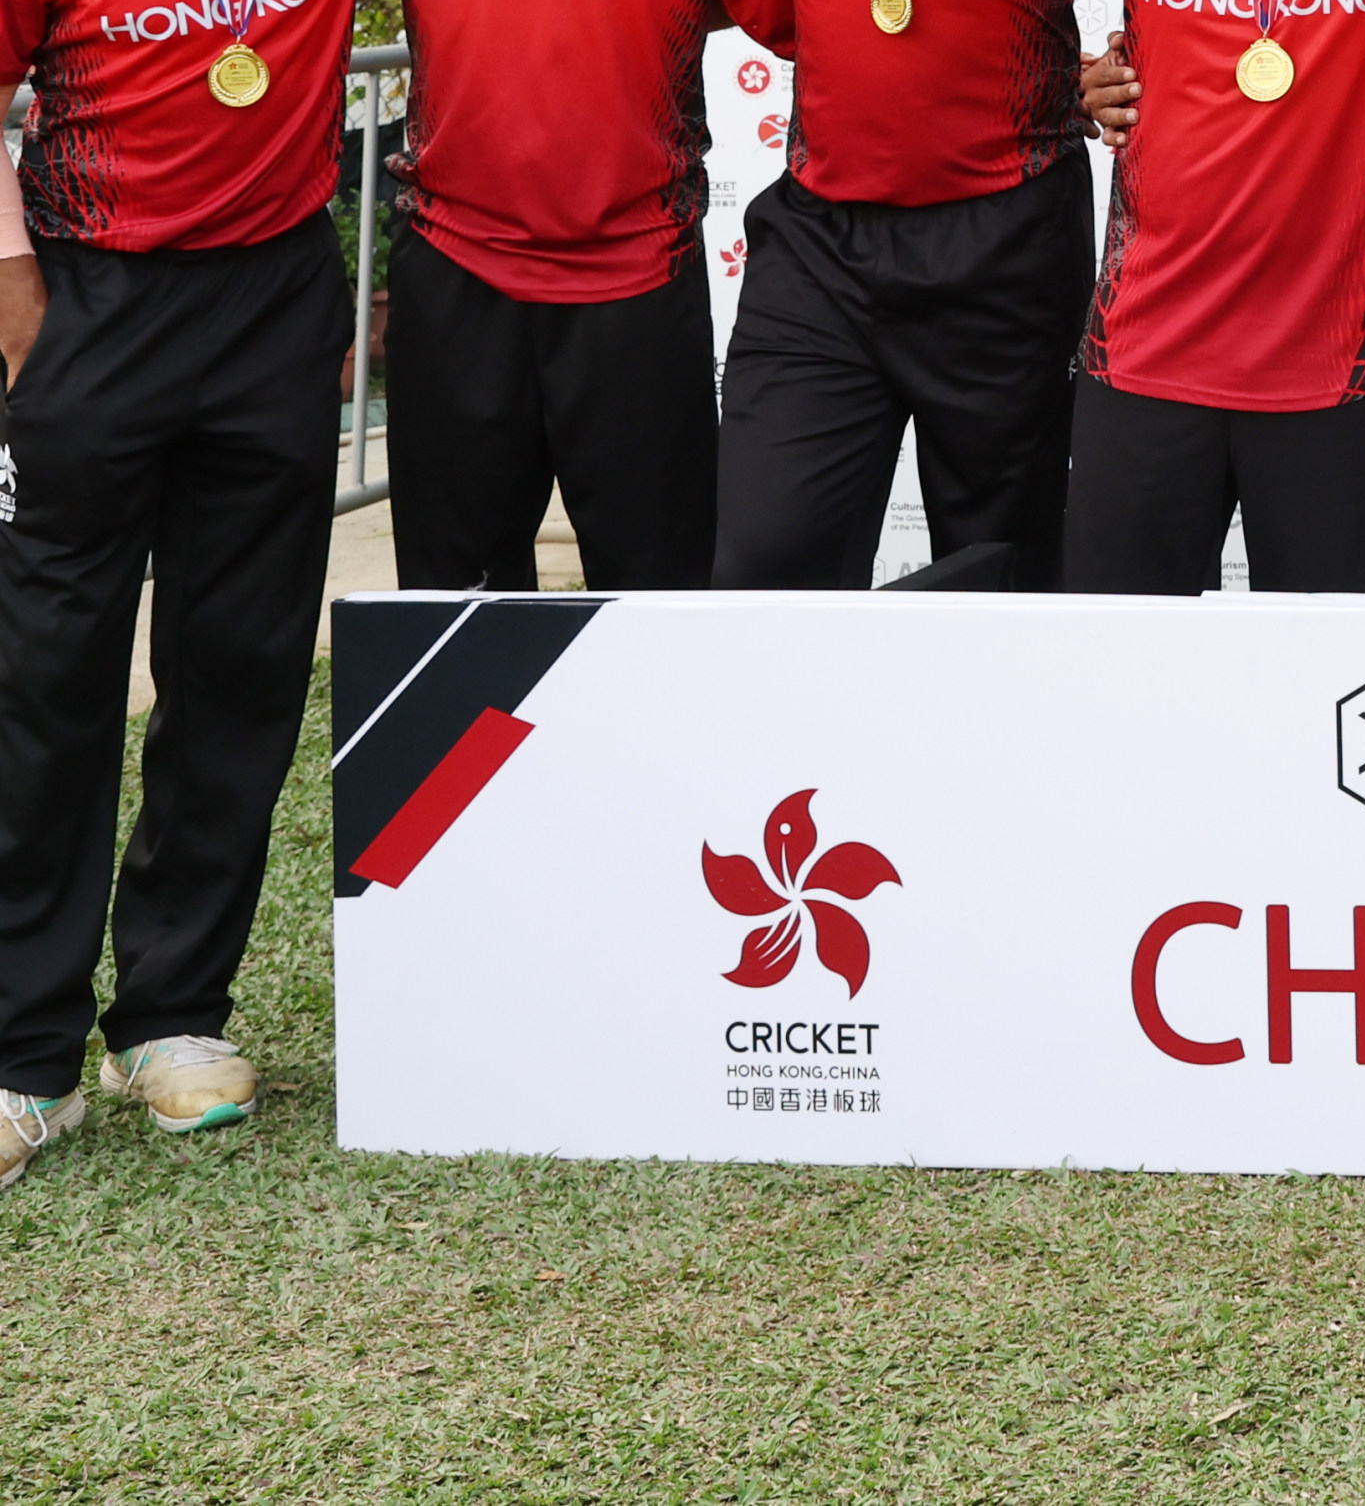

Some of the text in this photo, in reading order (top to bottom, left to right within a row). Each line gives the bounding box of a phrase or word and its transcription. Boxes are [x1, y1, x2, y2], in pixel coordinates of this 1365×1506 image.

[725, 1021, 880, 1055] CRICKET
[727, 1064, 773, 1078] HONG
[727, 1086, 881, 1113] 中國香港板球
